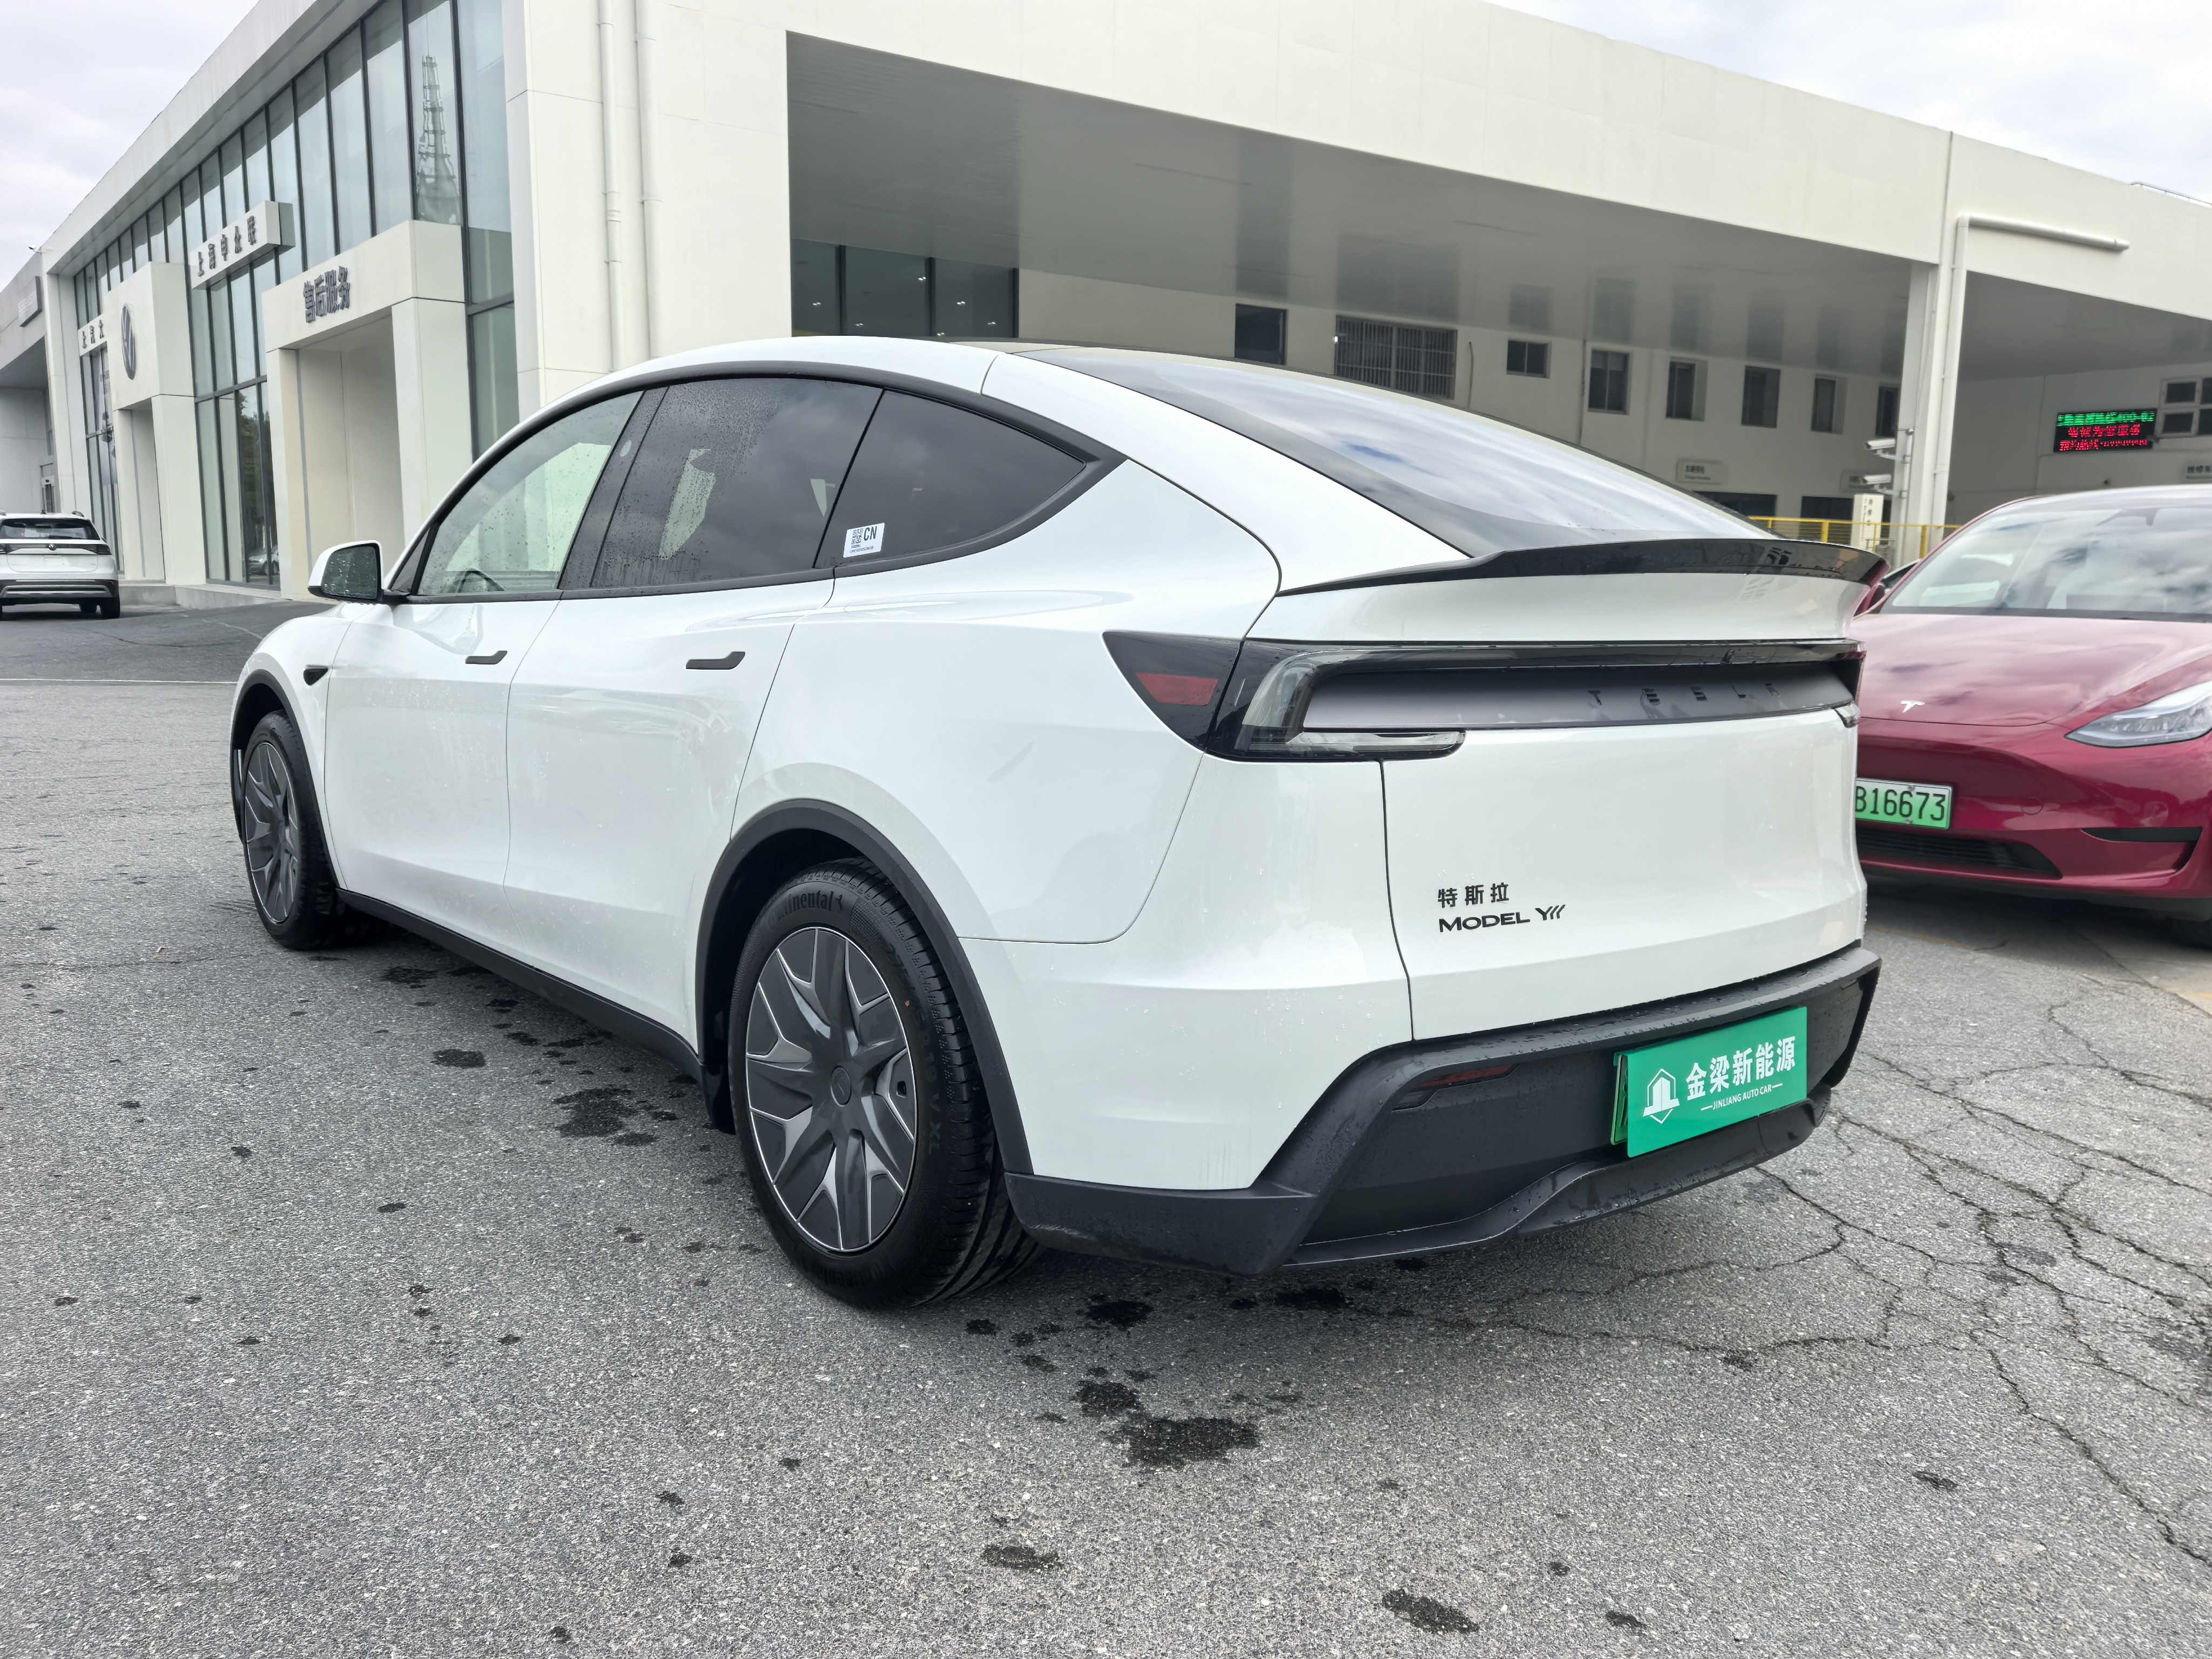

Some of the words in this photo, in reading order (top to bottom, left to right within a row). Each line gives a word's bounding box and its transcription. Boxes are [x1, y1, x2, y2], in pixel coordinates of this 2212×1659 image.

[303, 266, 350, 323] 售后服务
[864, 526, 878, 541] CN
[1855, 786, 1946, 821] B16673
[1438, 882, 1509, 908] 特斯拉
[1439, 912, 1531, 933] MODEL
[1685, 1036, 1796, 1101] 金梁新能源
[1712, 1094, 1742, 1110] JINLIANG
[1743, 1088, 1759, 1100] AUTO
[1760, 1084, 1772, 1095] CAR
